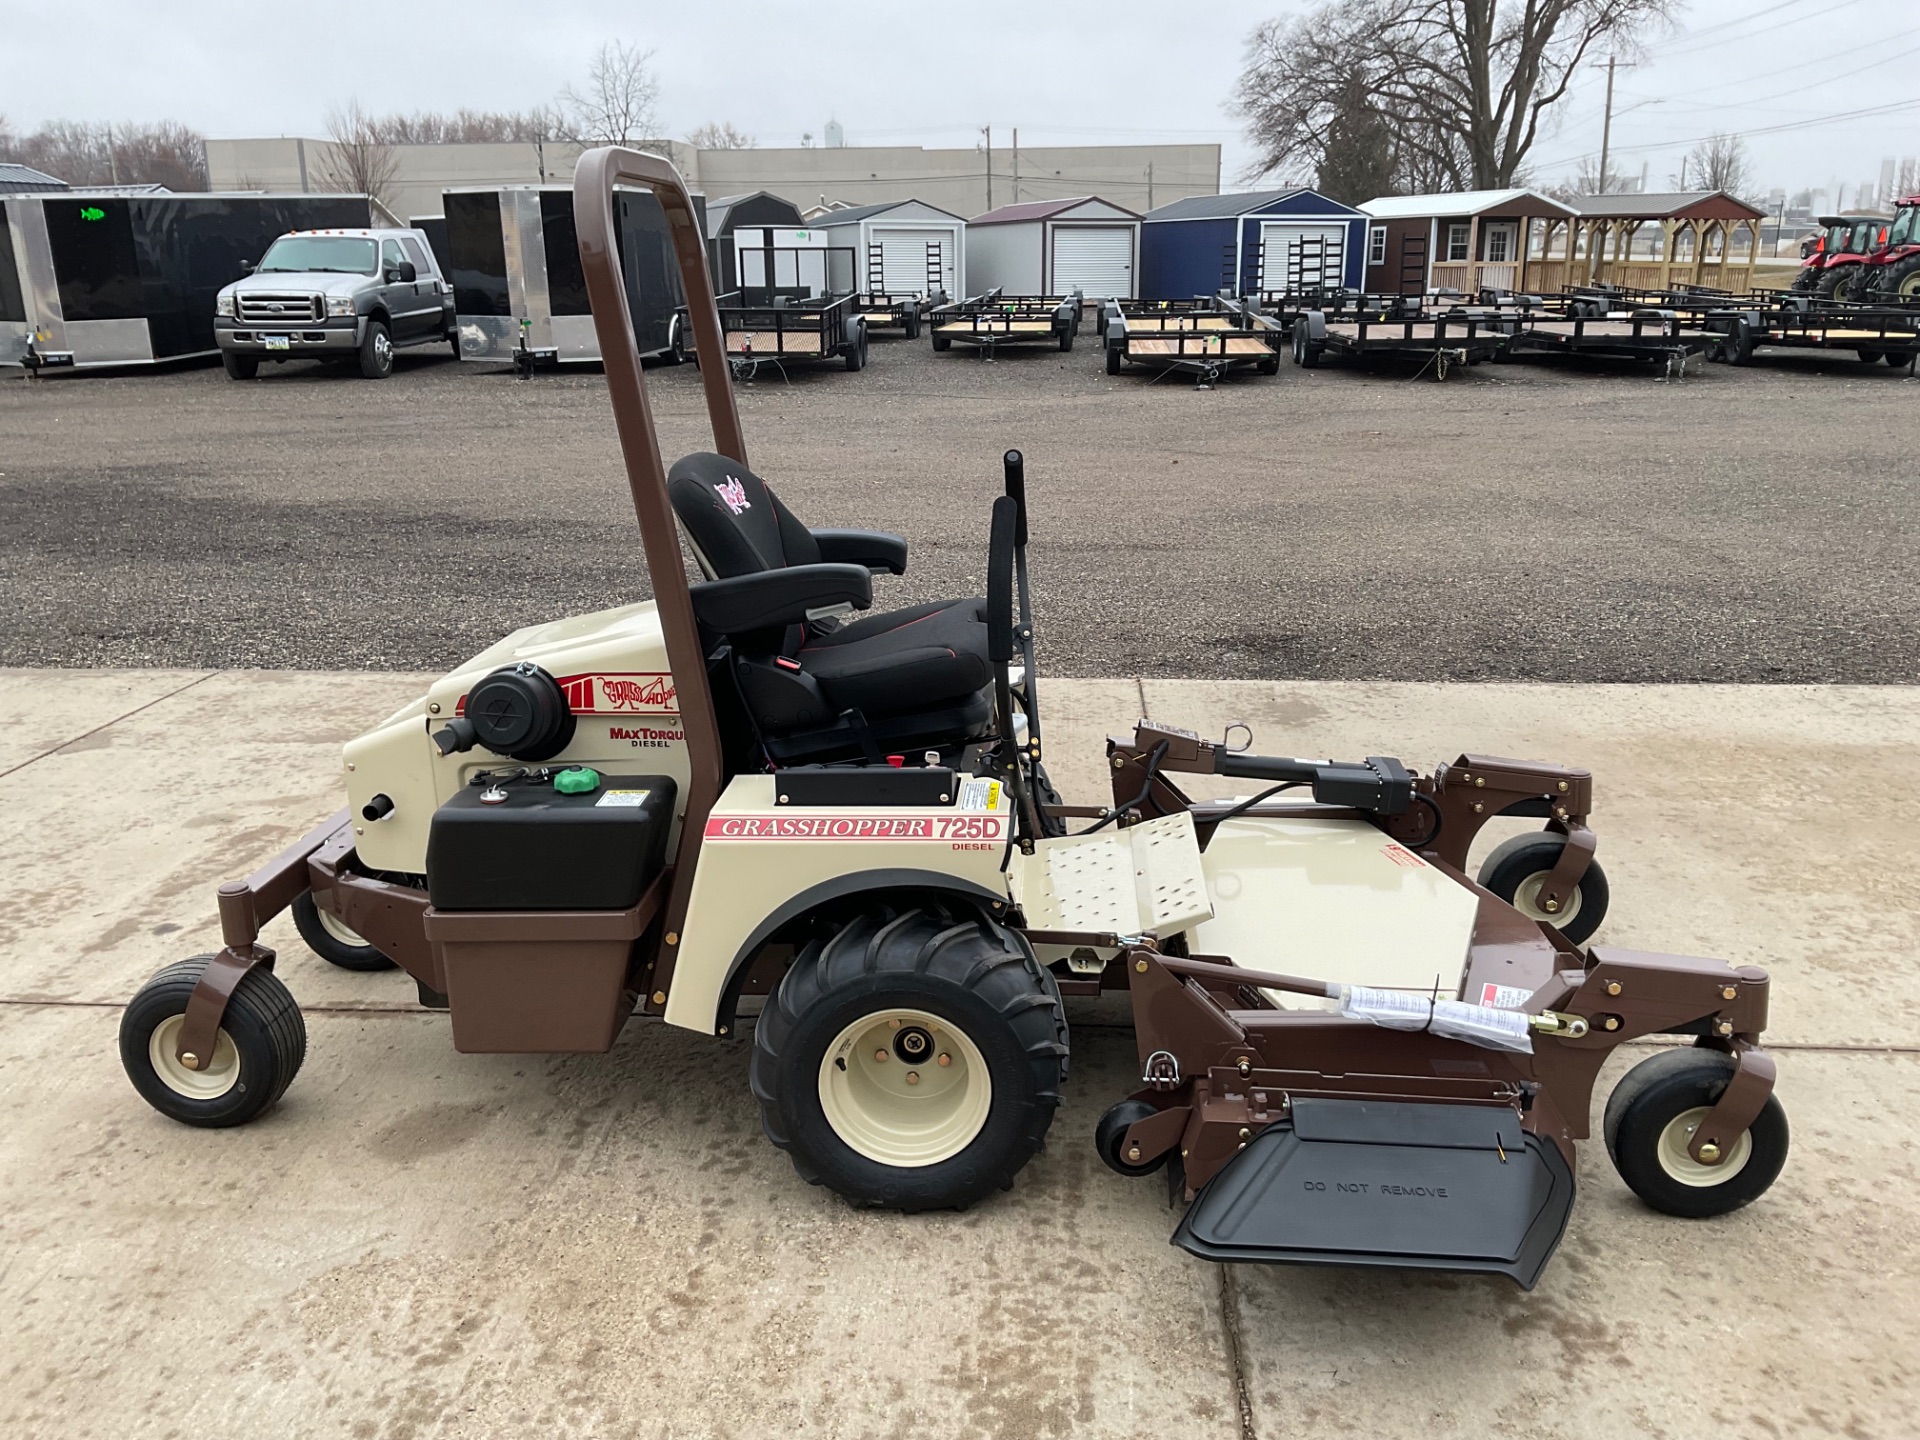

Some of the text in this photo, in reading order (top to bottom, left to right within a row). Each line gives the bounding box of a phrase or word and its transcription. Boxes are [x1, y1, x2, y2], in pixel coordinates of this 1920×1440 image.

[609, 728, 683, 740] MAXTORQU
[631, 740, 670, 748] DIESEL
[720, 817, 1001, 839] GRASSHOPPER 725D
[952, 843, 995, 851] DIESEL
[1303, 1181, 1449, 1198] DO NOT REMOVE
